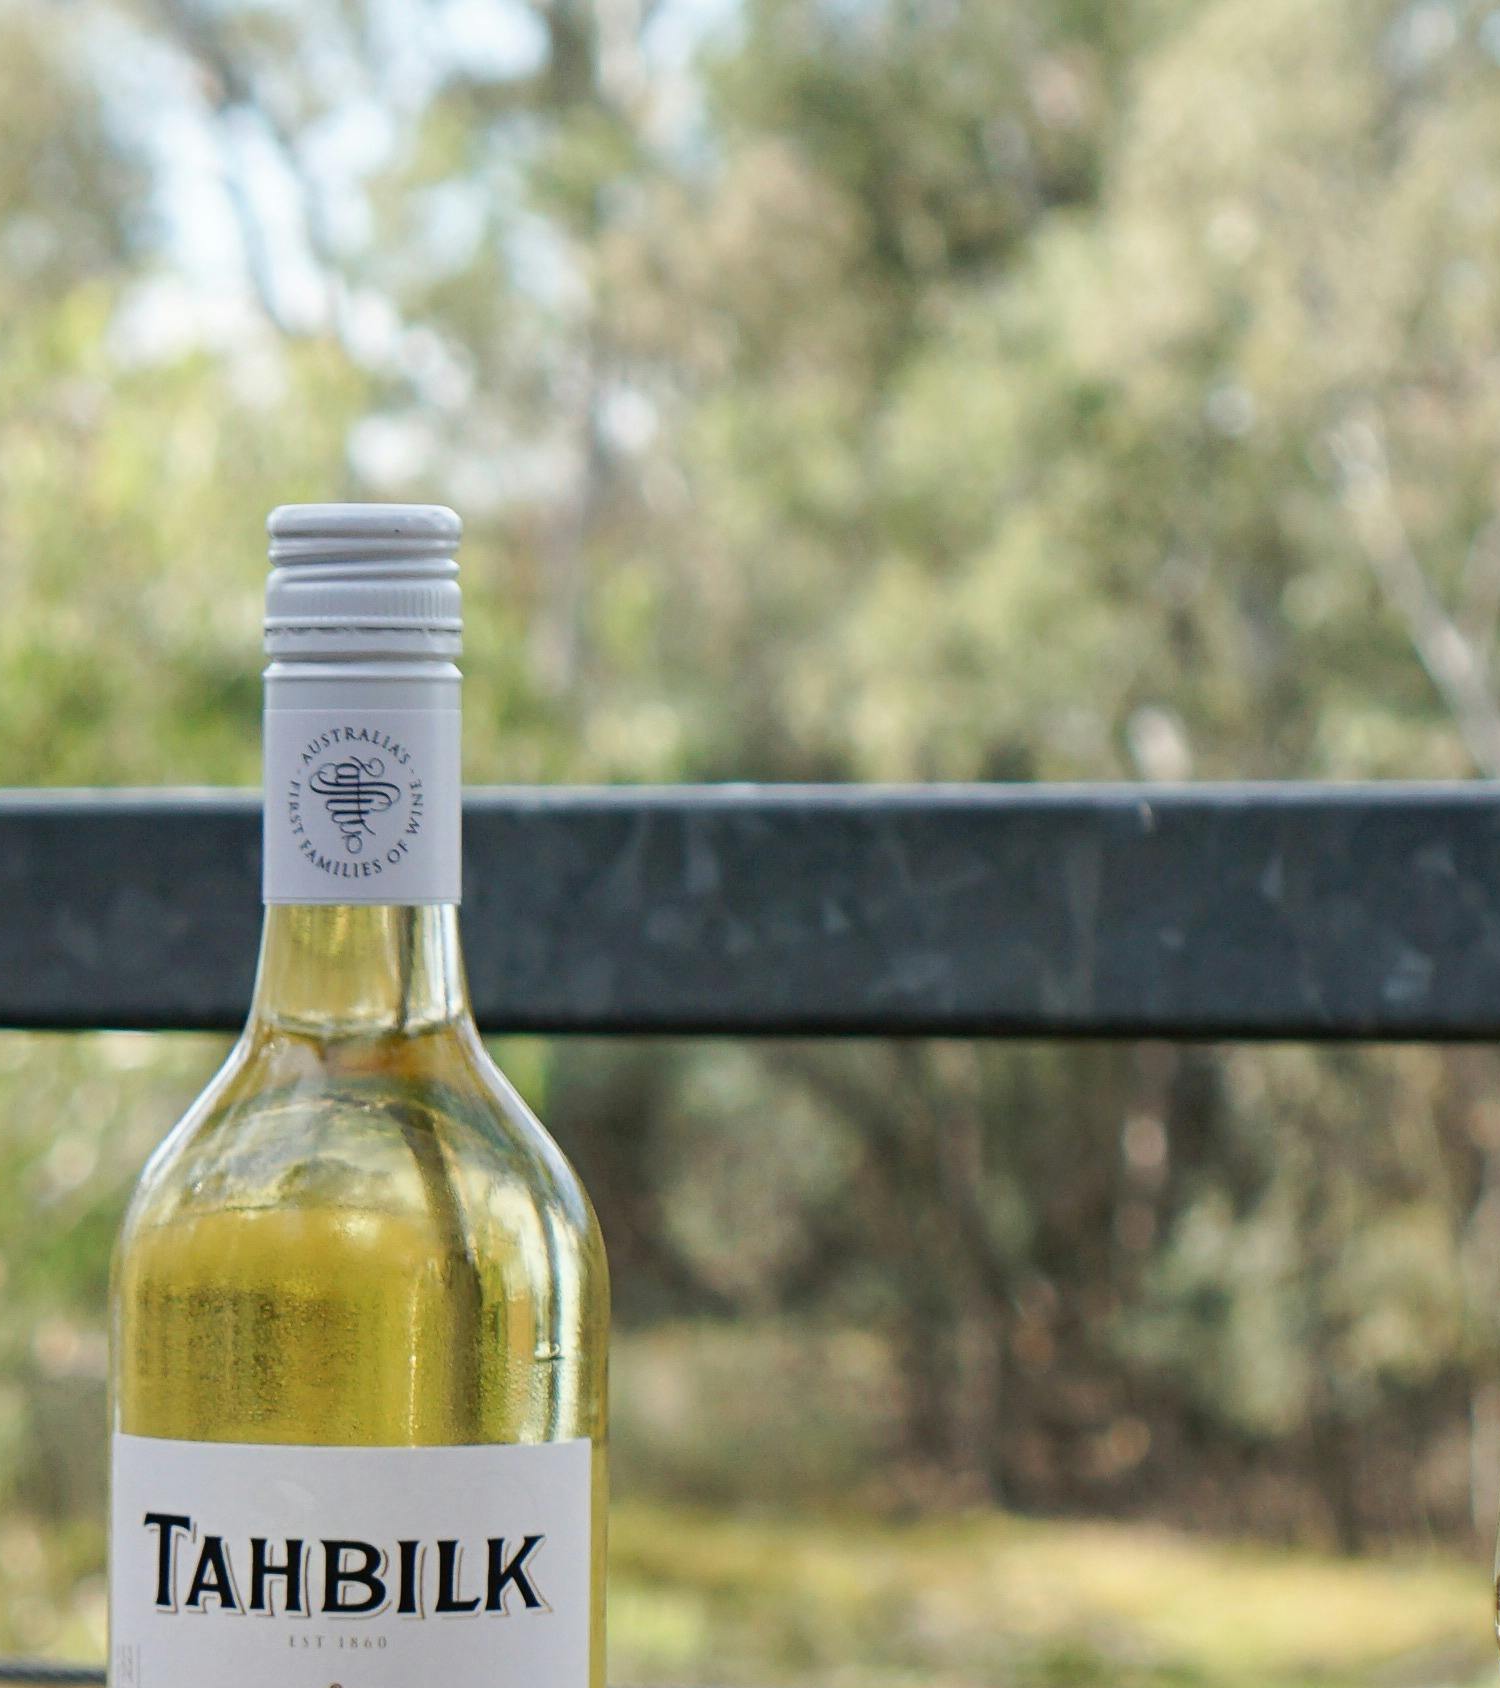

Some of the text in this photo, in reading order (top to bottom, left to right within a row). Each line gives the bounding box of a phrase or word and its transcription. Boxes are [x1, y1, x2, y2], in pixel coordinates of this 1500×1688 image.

[288, 778, 424, 878] FIRST FAMILIES OF WINE
[143, 1511, 554, 1621] TAHBILK
[289, 1633, 387, 1648] EST 1860
